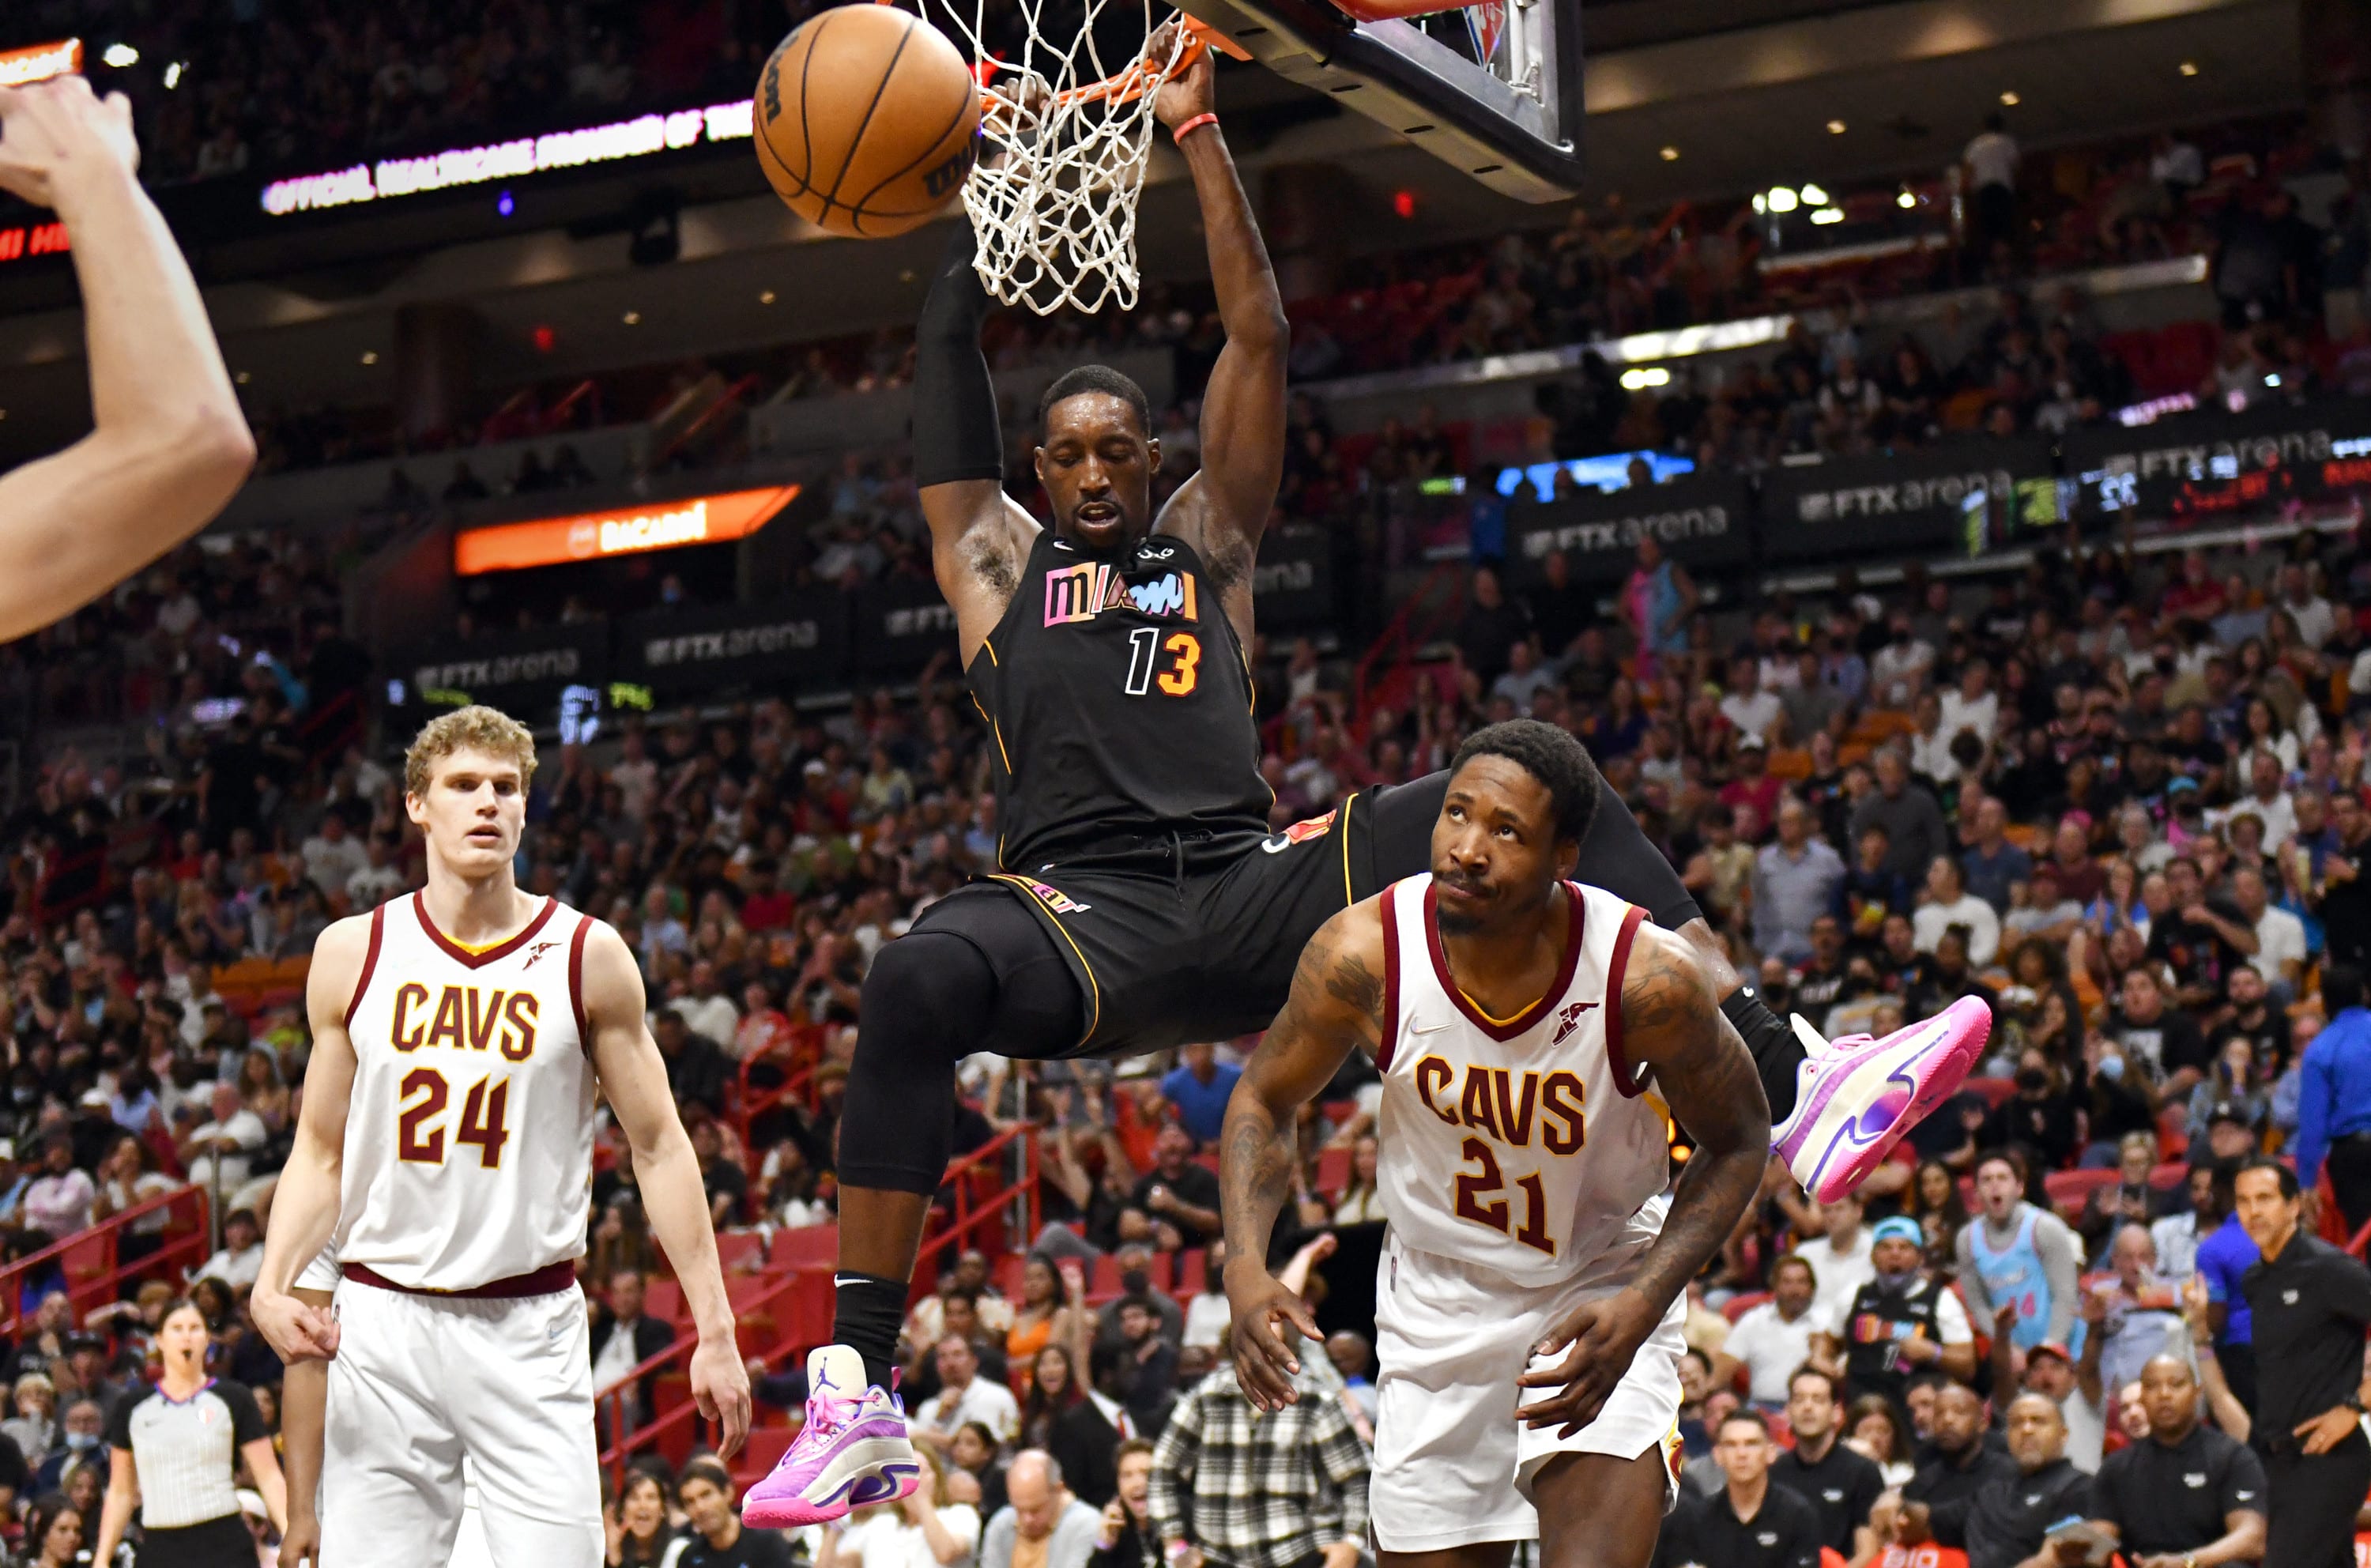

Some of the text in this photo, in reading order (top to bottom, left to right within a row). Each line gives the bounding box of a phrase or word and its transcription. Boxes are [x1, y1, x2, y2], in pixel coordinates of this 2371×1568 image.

[262, 162, 376, 215] OFFICIAL
[375, 138, 536, 198] HEALTHCARE
[535, 114, 665, 172] PROVIDER
[665, 108, 703, 149] OF
[1044, 561, 1199, 628] MIAMI
[1125, 627, 1202, 697] 13
[390, 981, 541, 1064] CAVS
[398, 1067, 511, 1170] 24
[1415, 1053, 1587, 1158] CAVS
[1453, 1133, 1557, 1257] 21
